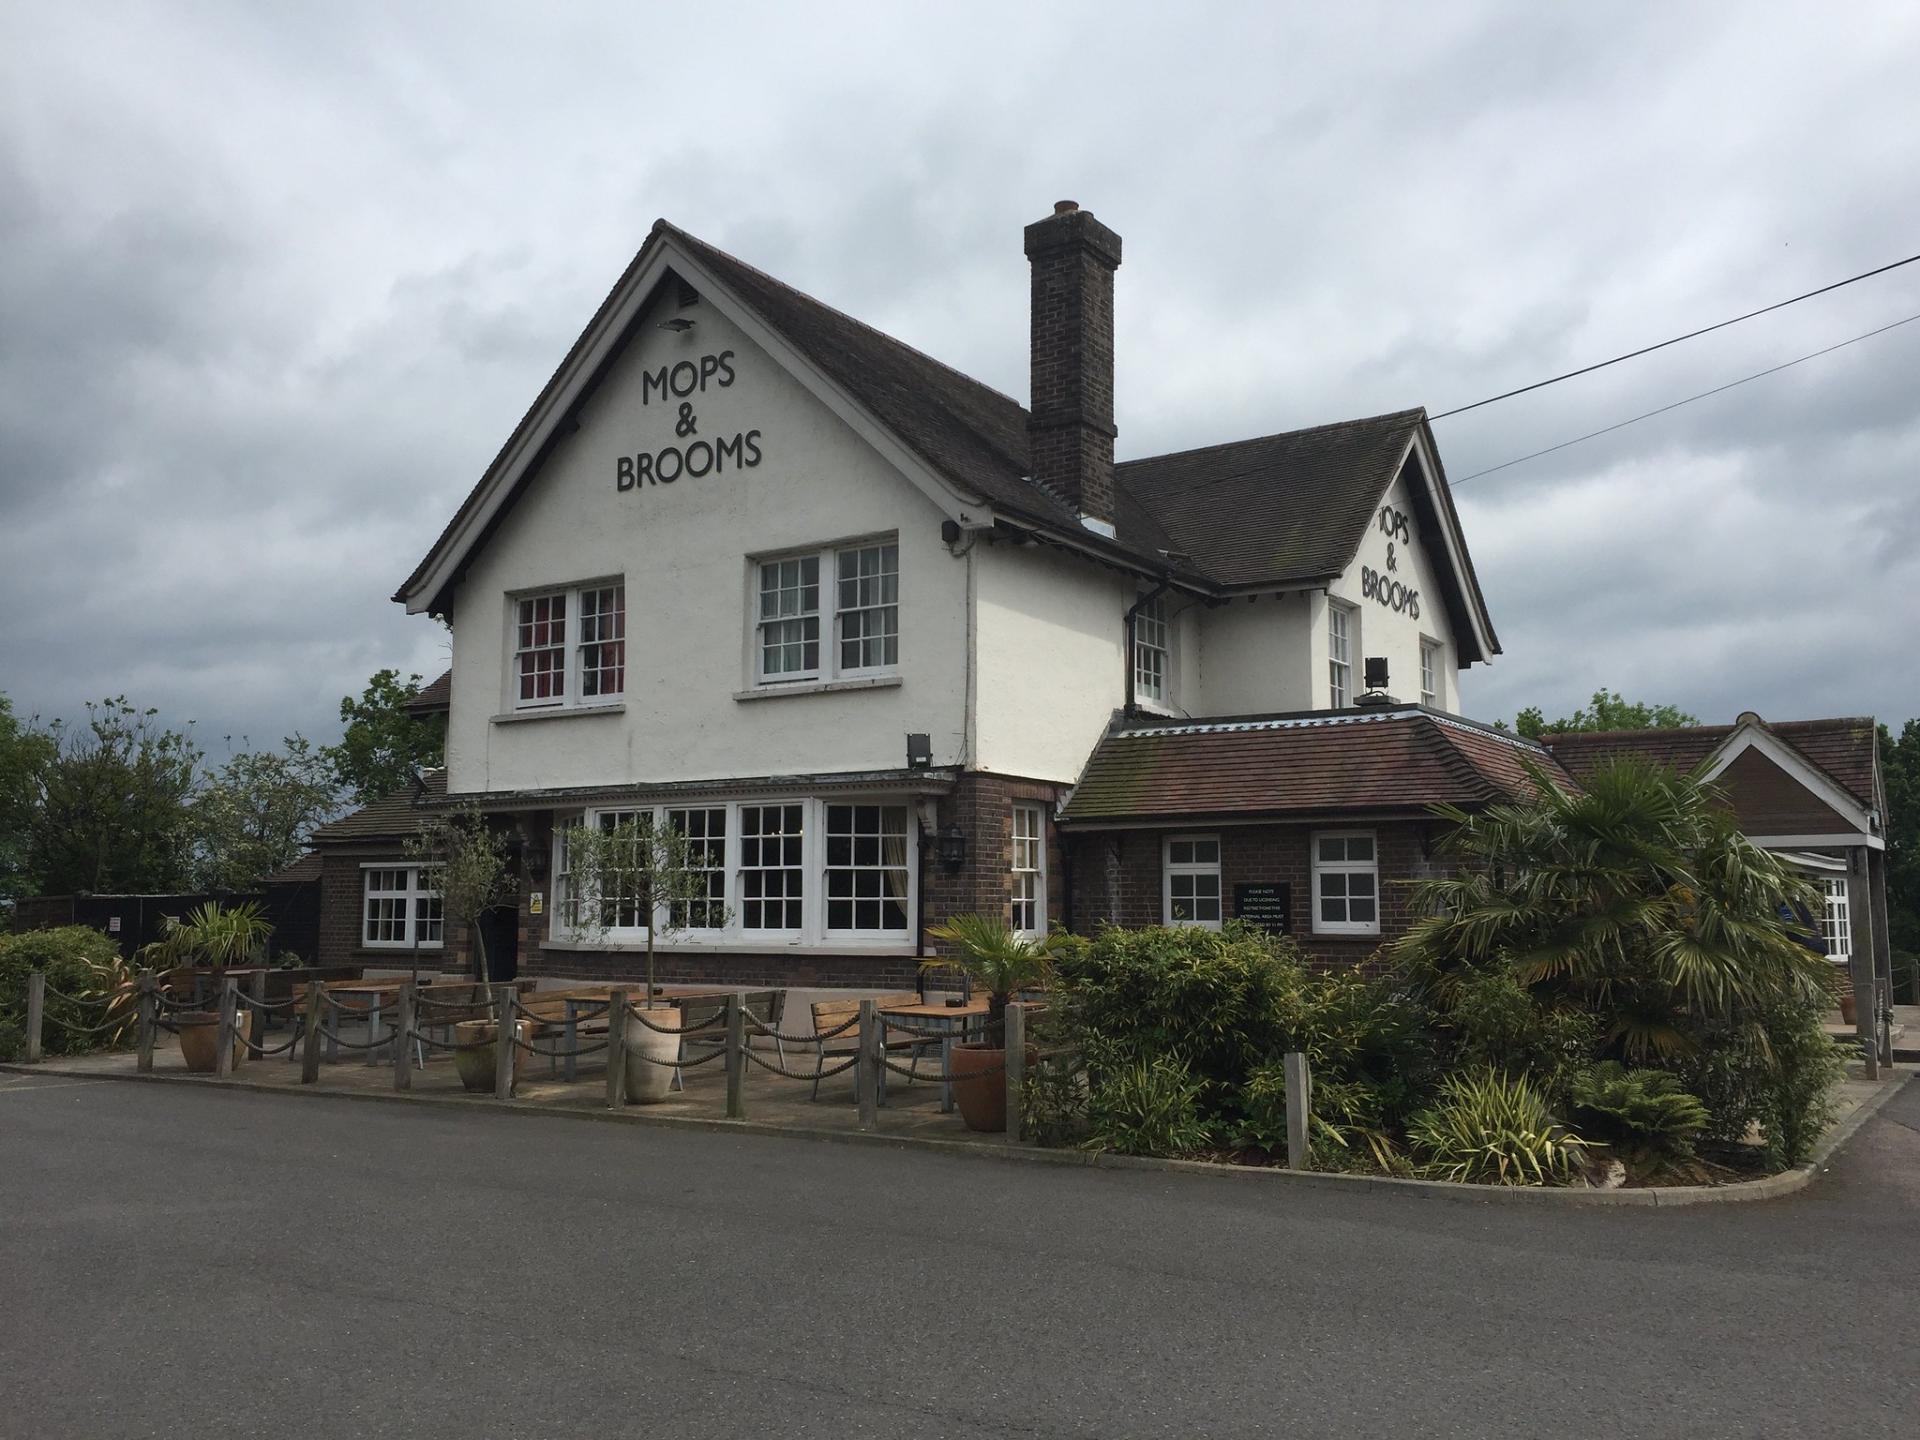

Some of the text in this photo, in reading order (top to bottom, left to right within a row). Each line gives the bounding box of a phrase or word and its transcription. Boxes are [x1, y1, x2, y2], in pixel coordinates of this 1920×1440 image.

[643, 350, 735, 405] MOPS
[675, 401, 697, 438] &
[617, 429, 762, 492] BROOMS
[1386, 542, 1398, 574] &
[1361, 565, 1420, 620] BROOMS
